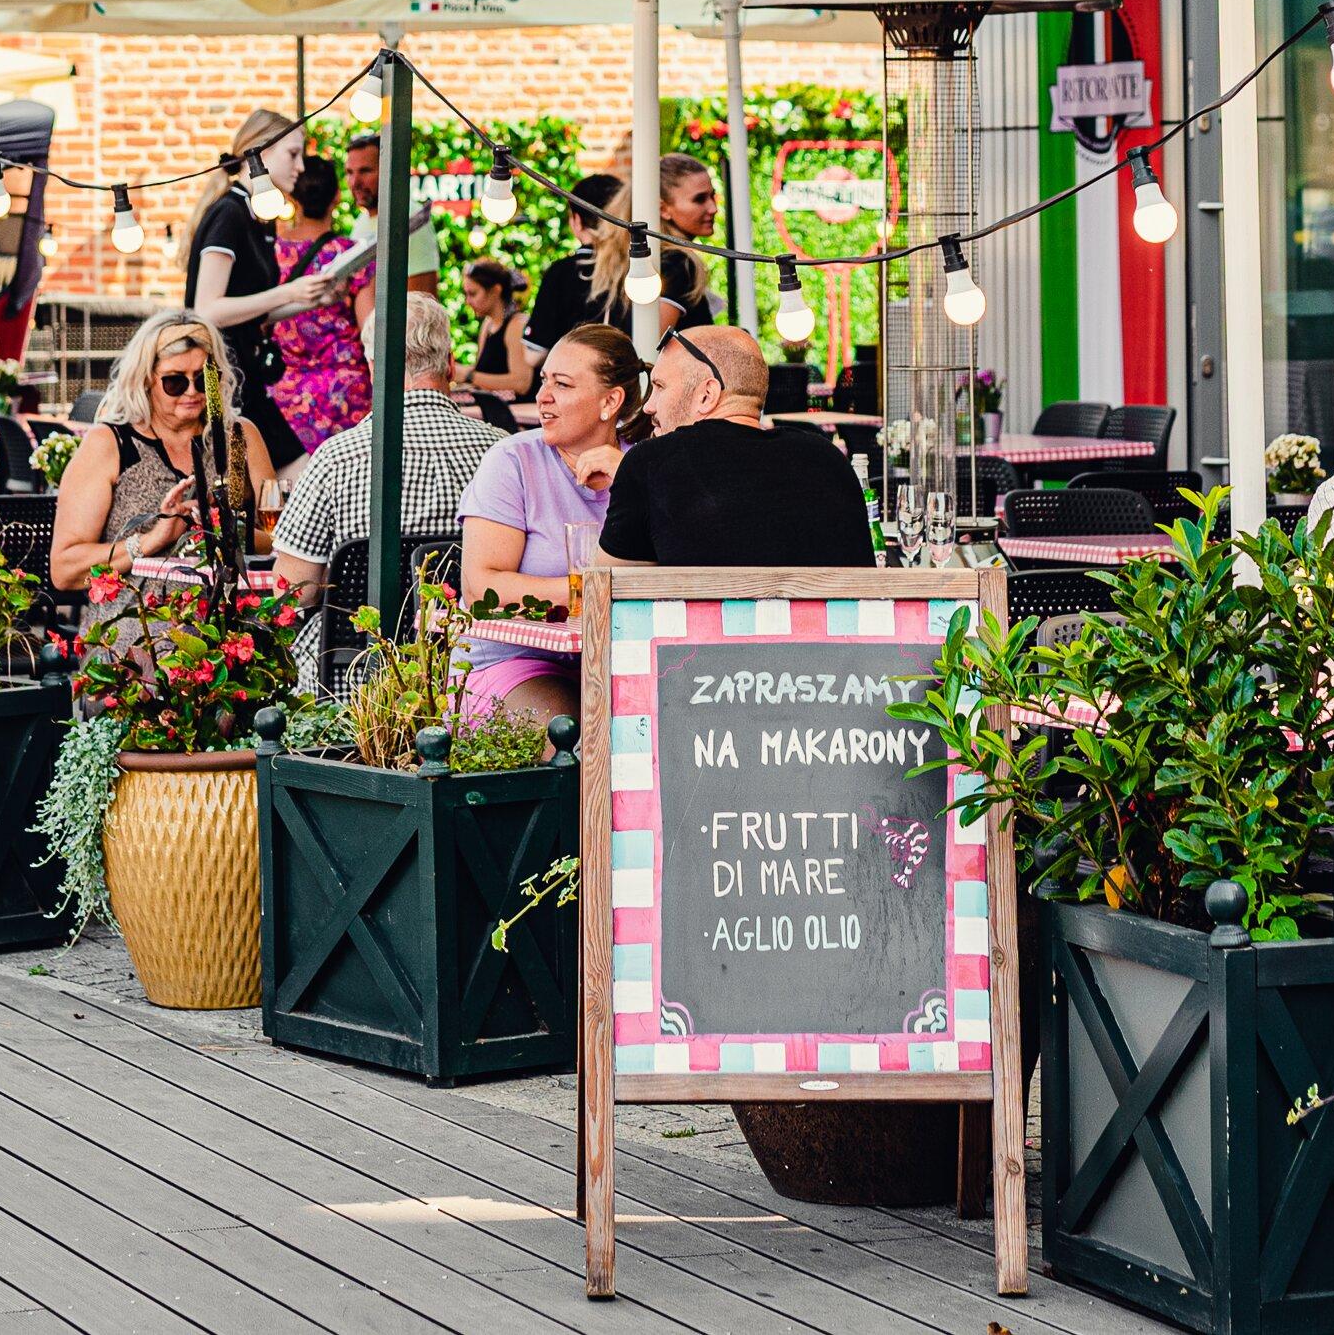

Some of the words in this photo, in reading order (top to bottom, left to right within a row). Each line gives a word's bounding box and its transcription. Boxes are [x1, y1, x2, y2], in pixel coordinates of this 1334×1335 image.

[688, 670, 919, 707] ZAPRASZAMY
[694, 728, 740, 769] NA
[761, 727, 931, 767] MAKARONY
[713, 860, 744, 897] DI
[759, 858, 847, 897] MARE
[804, 914, 862, 951] OLIO
